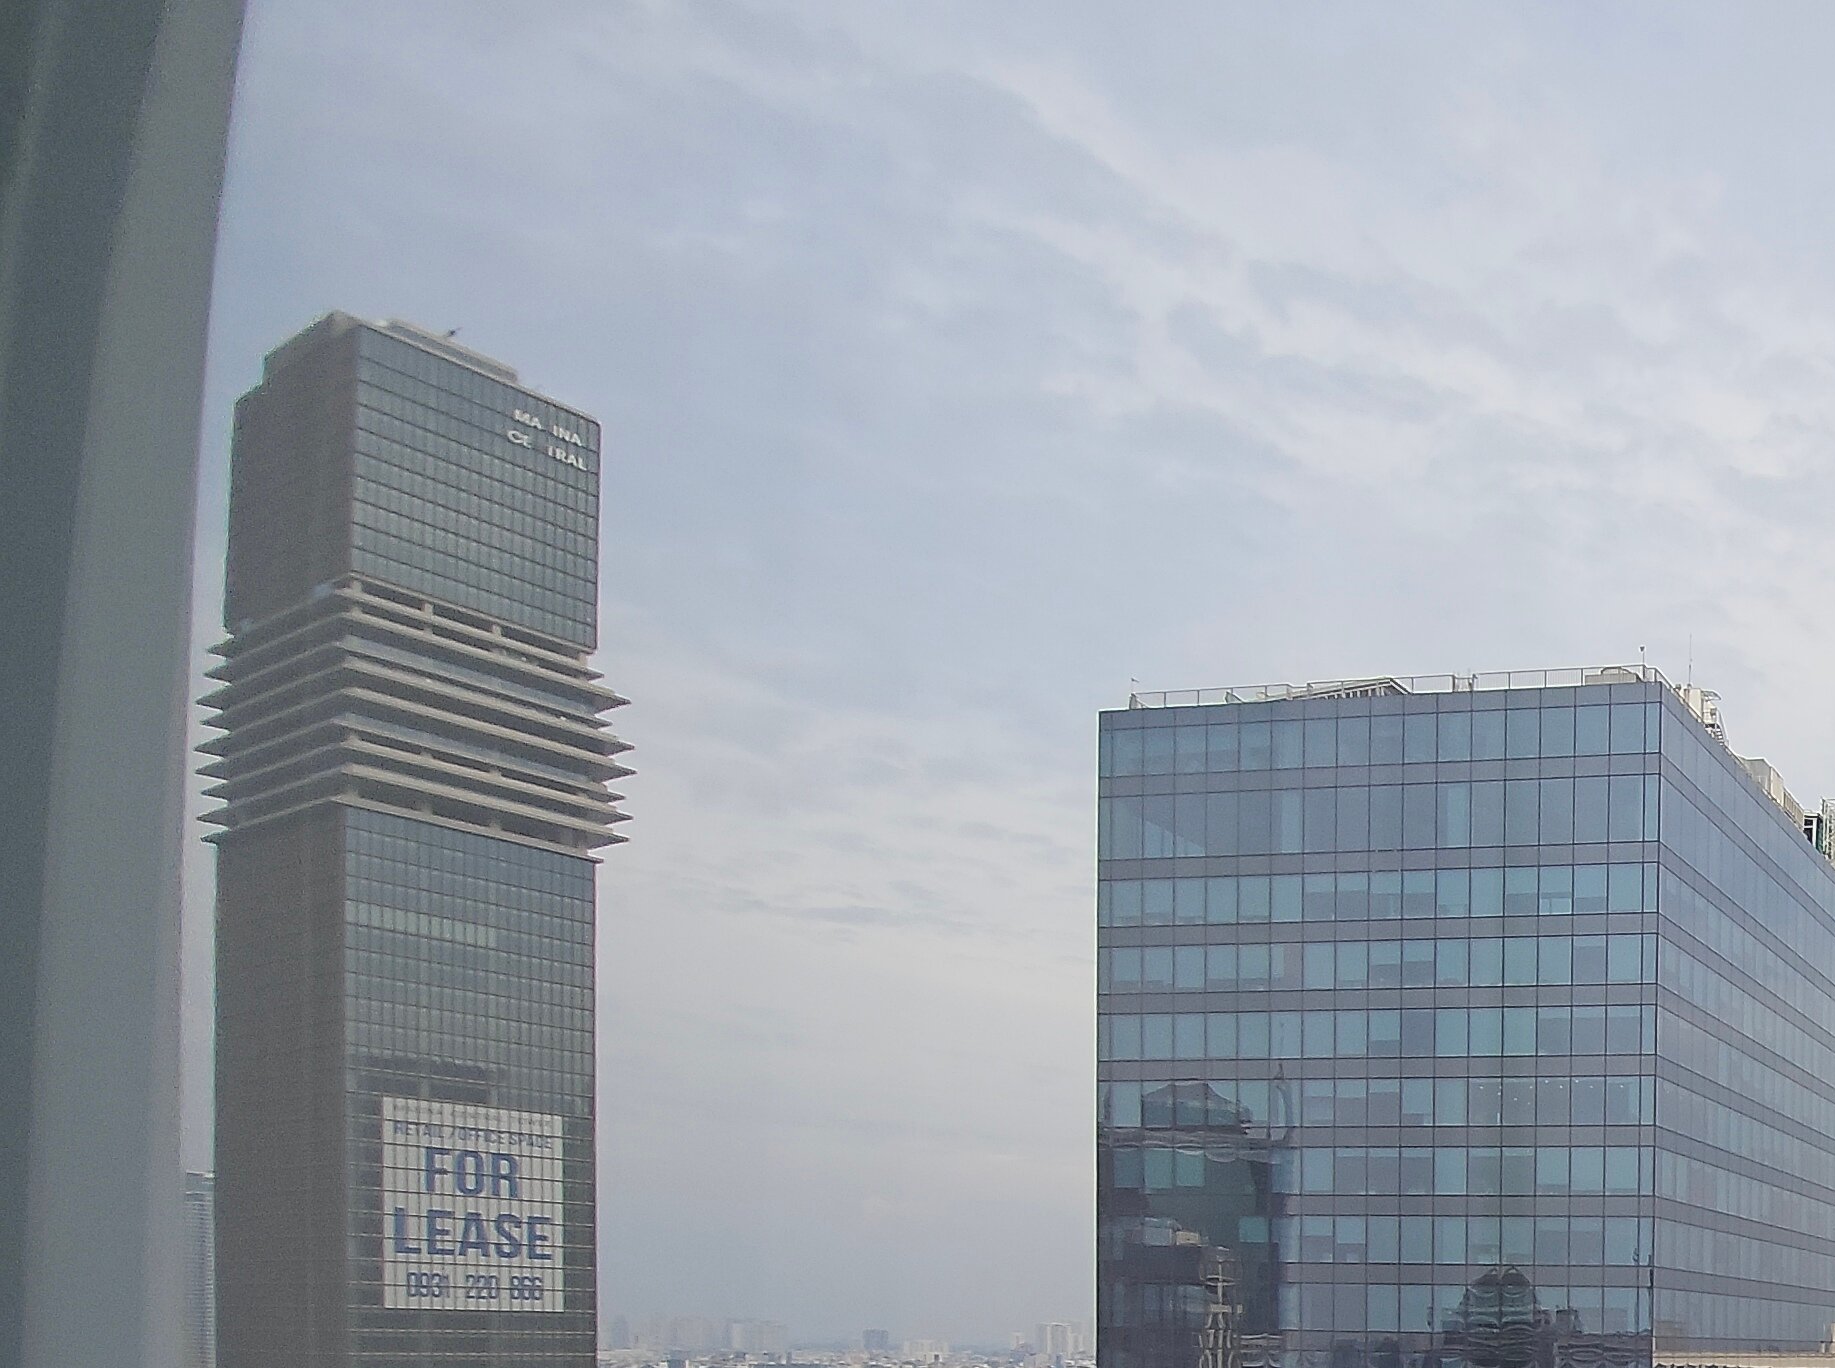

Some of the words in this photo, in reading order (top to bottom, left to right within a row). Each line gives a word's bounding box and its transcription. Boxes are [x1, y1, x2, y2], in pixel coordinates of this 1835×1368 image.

[513, 408, 582, 447] MAINA
[425, 1147, 518, 1199] FOR
[394, 1206, 553, 1260] LEASE
